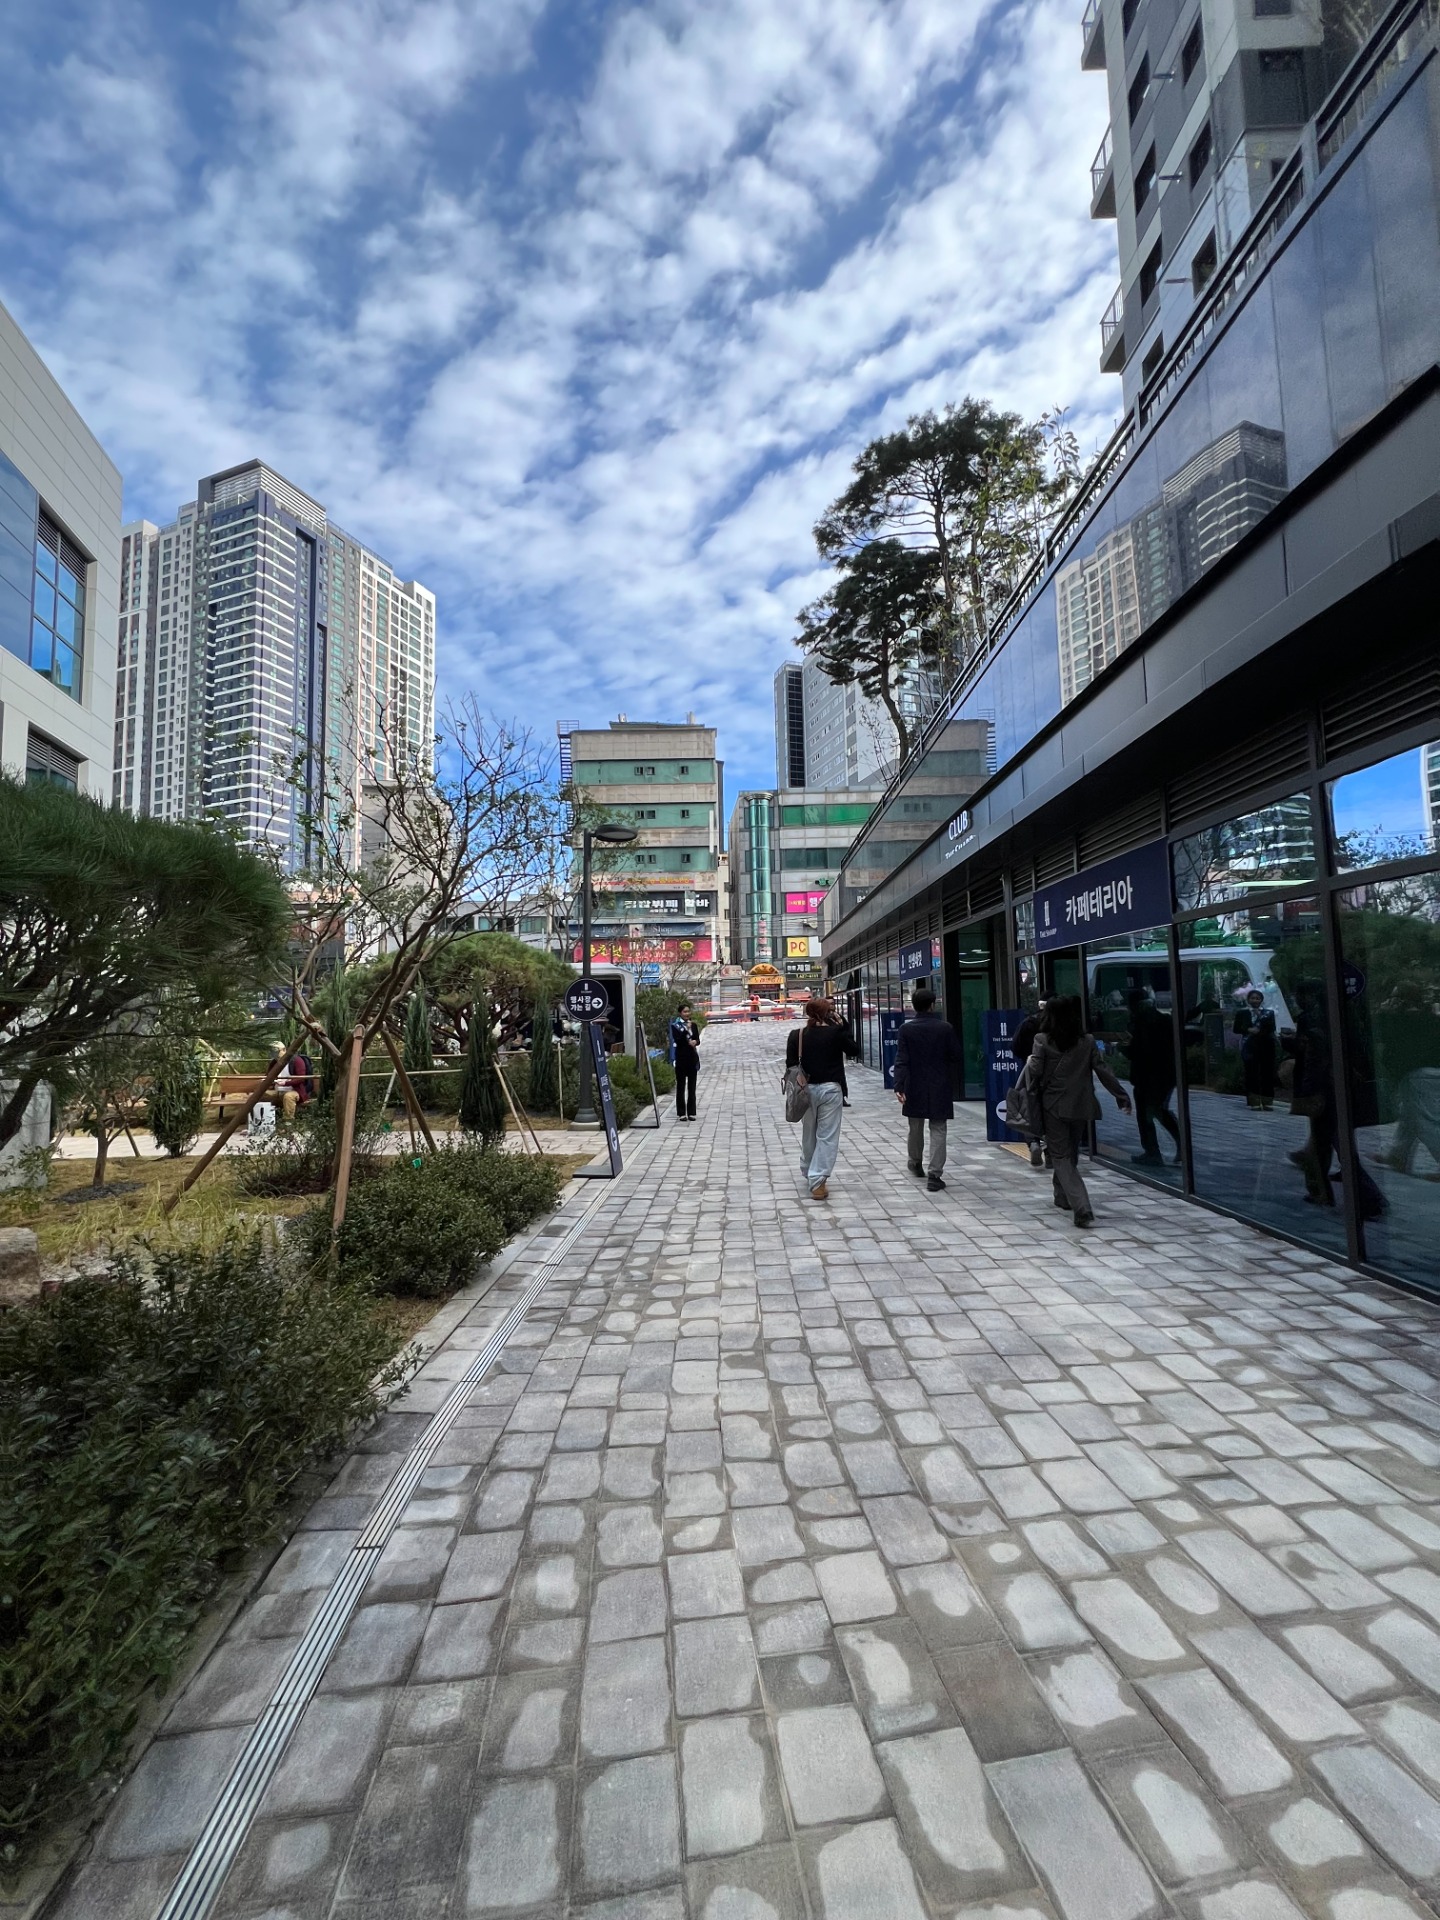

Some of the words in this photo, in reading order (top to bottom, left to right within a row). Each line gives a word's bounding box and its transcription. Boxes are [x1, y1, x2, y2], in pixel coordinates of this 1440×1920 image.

[948, 809, 969, 841] CLUB
[1065, 875, 1134, 926] 카페테리아
[790, 941, 806, 953] PC
[570, 995, 592, 1004] 행사장
[570, 1004, 583, 1012] 가는
[584, 1004, 592, 1012] 길
[996, 1049, 1014, 1060] 카페
[992, 1062, 1019, 1072] 테리아
